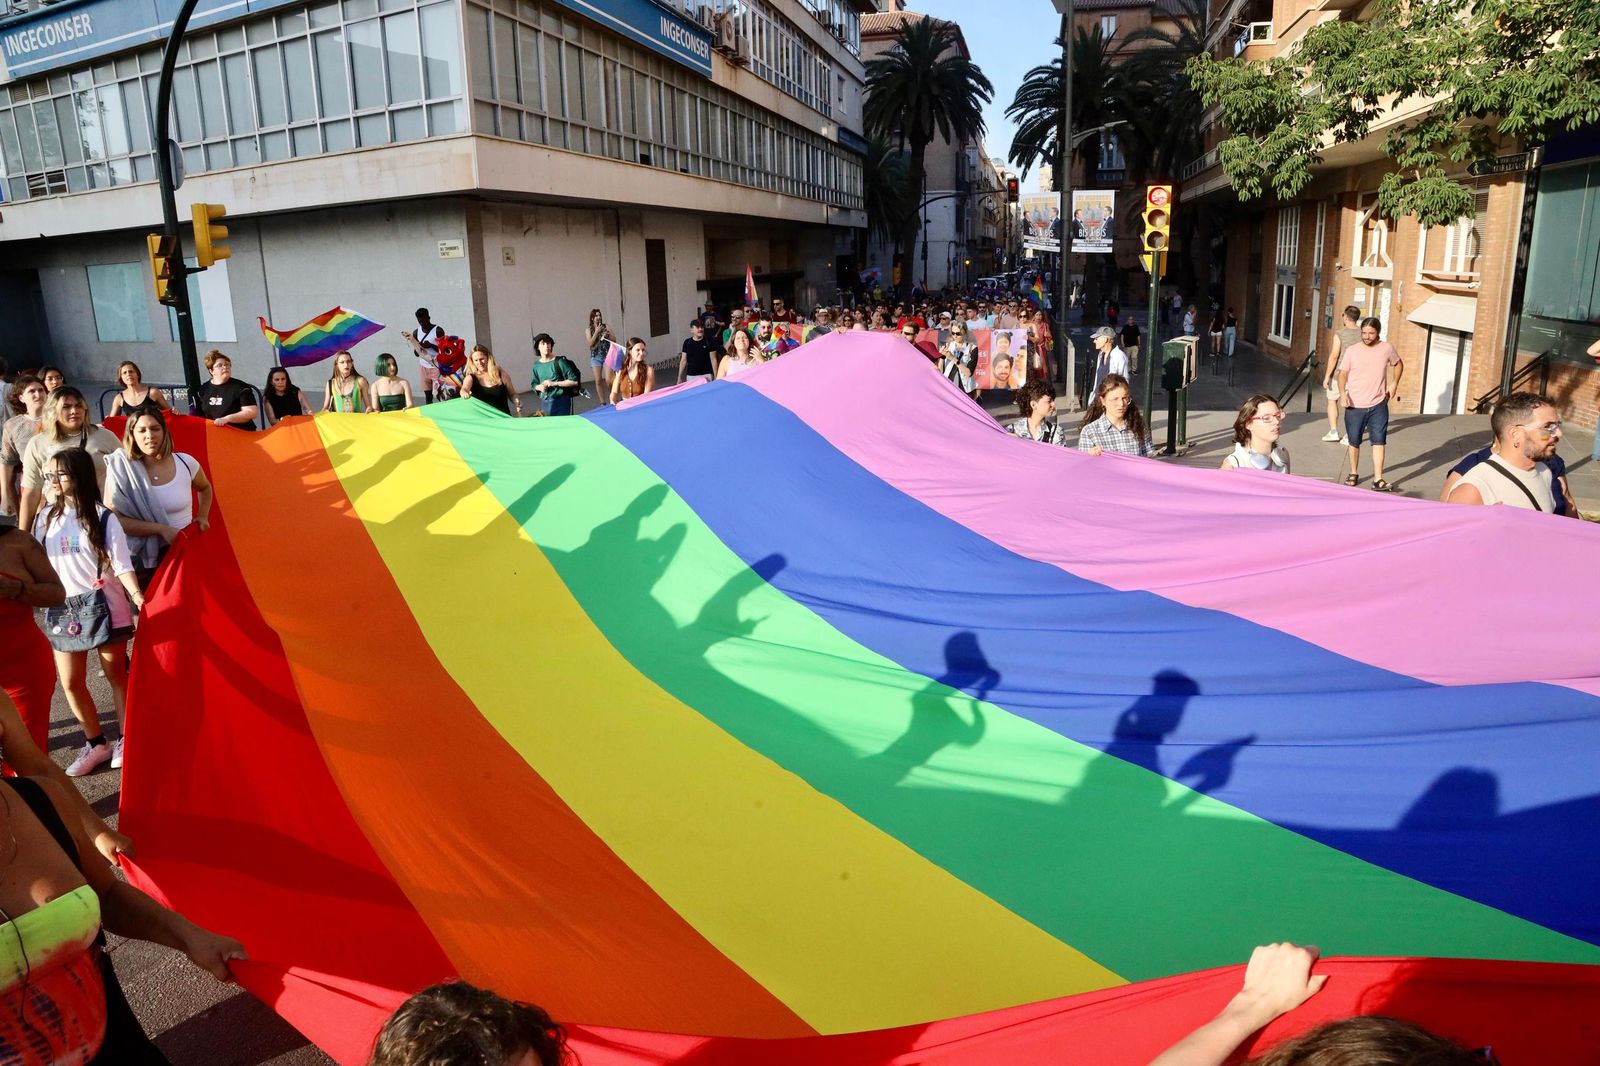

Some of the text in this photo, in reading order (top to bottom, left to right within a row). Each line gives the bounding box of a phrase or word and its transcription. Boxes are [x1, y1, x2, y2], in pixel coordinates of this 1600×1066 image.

[4, 13, 93, 57] INGECONSER
[660, 16, 710, 60] INGECONSER
[1078, 228, 1088, 237] BIS
[1096, 228, 1106, 237] BIS
